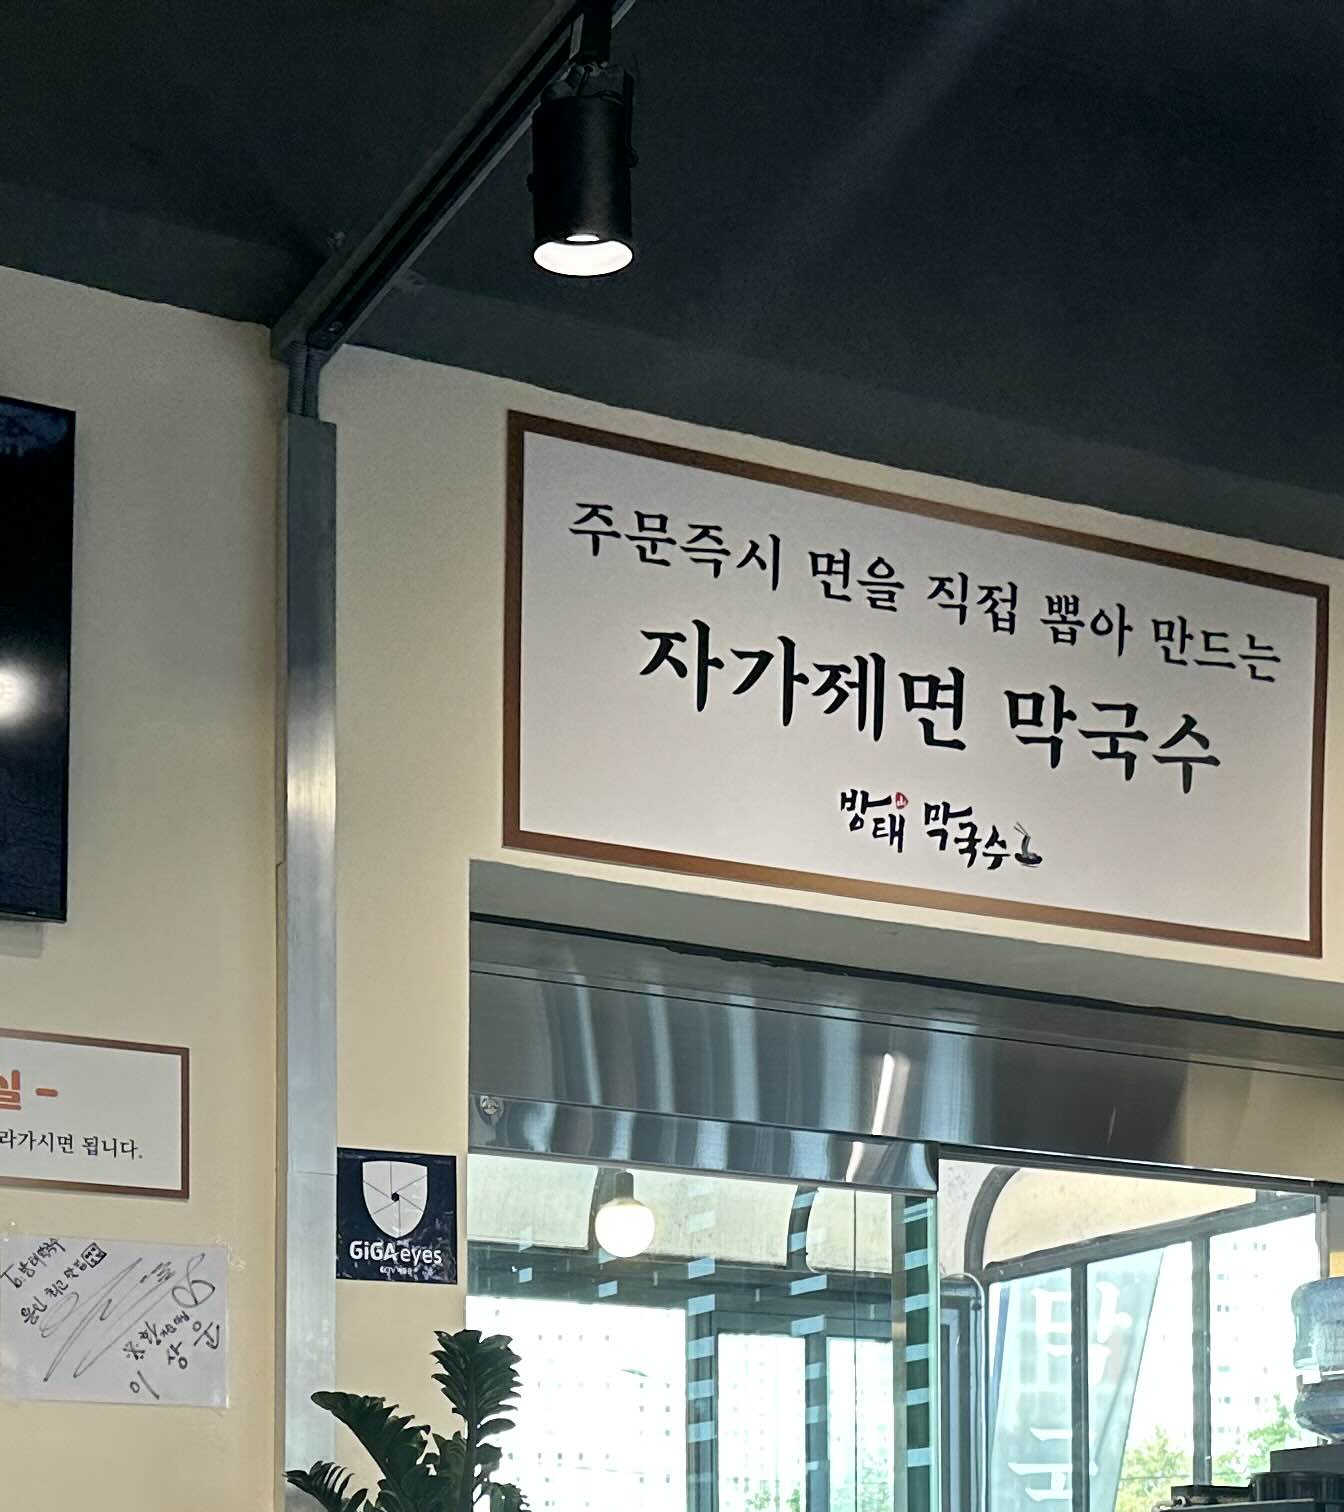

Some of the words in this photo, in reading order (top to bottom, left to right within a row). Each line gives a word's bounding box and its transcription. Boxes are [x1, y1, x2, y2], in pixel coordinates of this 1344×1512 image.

[569, 502, 783, 592] 주문즉시
[808, 547, 906, 612] 면을
[927, 570, 1019, 637] 직접
[1040, 593, 1134, 657] 뽑아
[1151, 615, 1283, 684] 만드는
[638, 618, 969, 752] 자가제면
[1002, 683, 1222, 795] 막국수
[840, 789, 907, 853] 방태
[924, 802, 1014, 871] 막국수
[82, 1135, 144, 1161] 됩니다.
